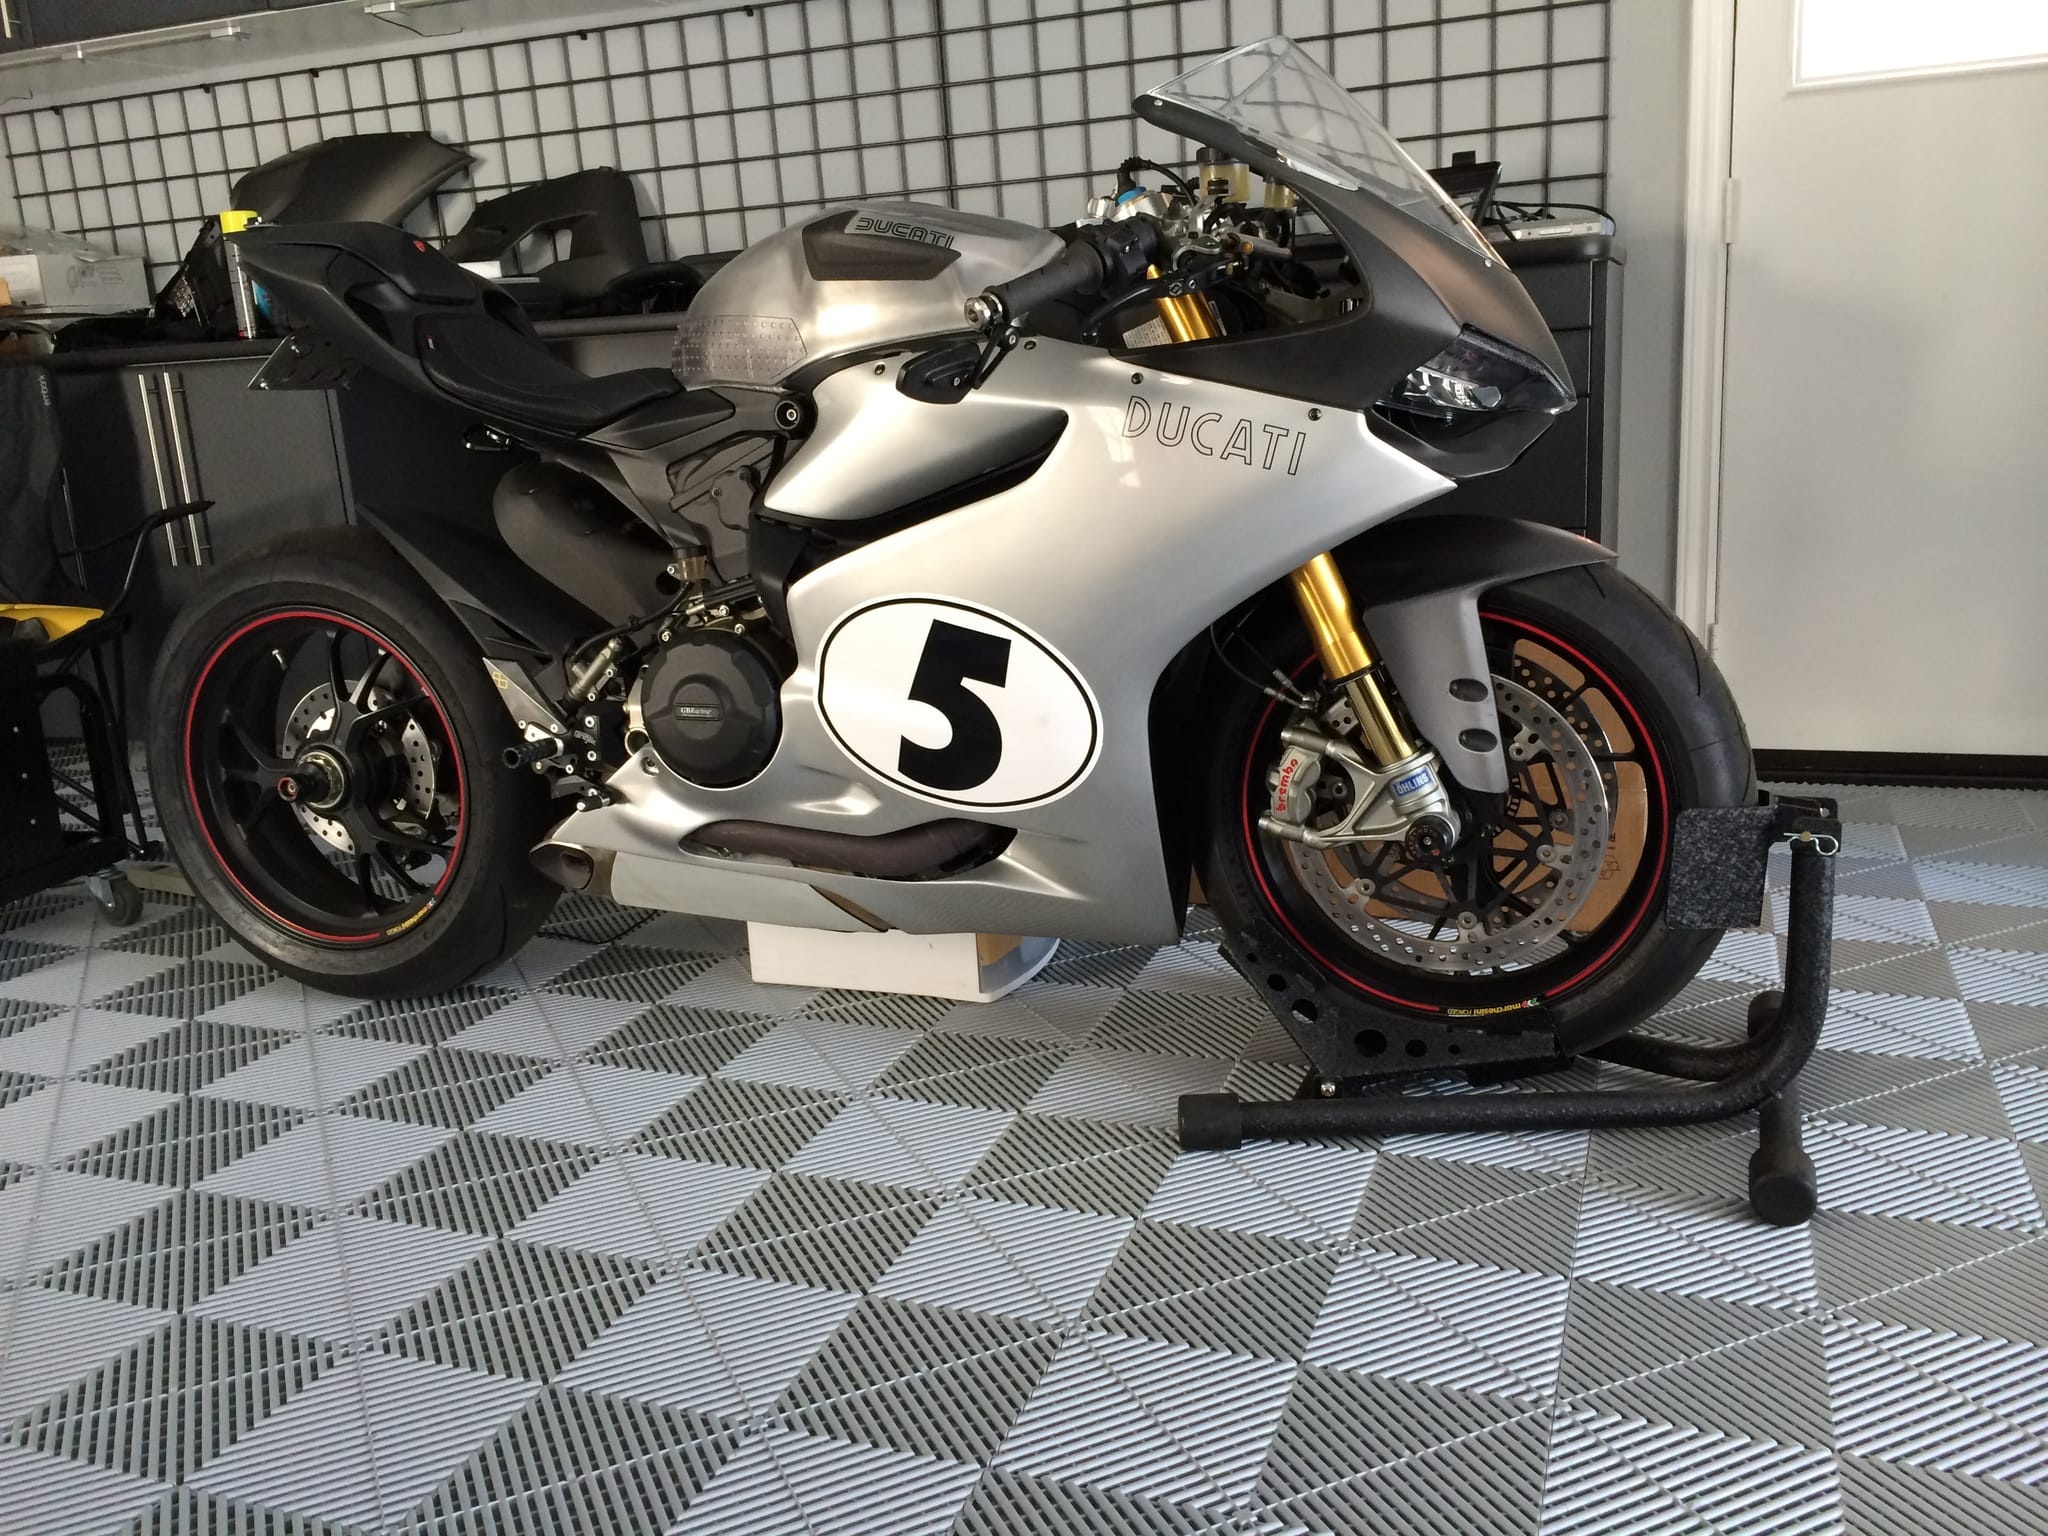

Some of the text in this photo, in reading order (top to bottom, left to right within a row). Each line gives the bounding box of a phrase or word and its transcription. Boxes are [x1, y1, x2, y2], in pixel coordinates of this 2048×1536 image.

[855, 217, 955, 249] DUCATI
[1121, 395, 1306, 476] DUCATI
[898, 618, 1012, 791] 5
[1275, 758, 1299, 811] brembo
[1473, 1002, 1521, 1015] marchesini
